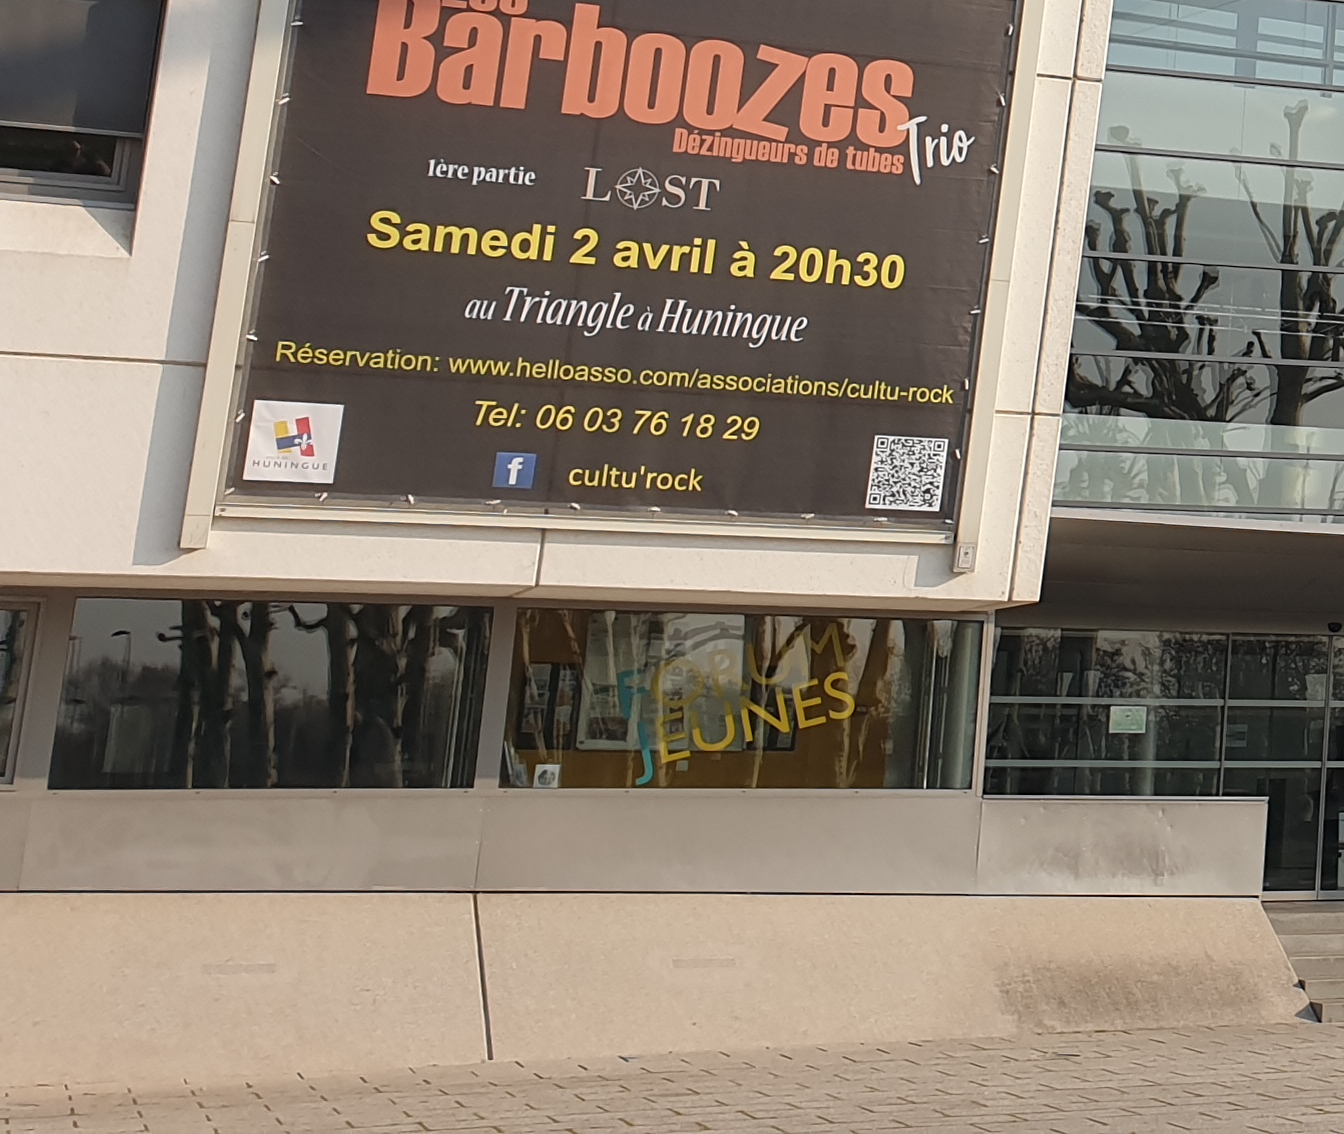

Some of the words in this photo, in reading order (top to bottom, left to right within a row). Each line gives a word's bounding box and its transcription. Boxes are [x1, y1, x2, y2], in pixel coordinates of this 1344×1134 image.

[471, 166, 537, 186] partie
[672, 127, 808, 166] Dézingueurs
[812, 142, 840, 169] de
[845, 146, 905, 175] tubes
[896, 115, 976, 186] Trio
[366, 210, 556, 262] Samedi
[568, 228, 599, 265] 2
[612, 237, 717, 275] avril
[729, 241, 756, 278] à
[769, 244, 906, 290] 20h30
[464, 298, 497, 321] au
[502, 286, 635, 337] Triangle
[636, 306, 654, 332] à
[655, 298, 809, 349] Huningue
[275, 341, 440, 373] Réservation:
[448, 356, 955, 405] www.helloasso.com/associations/cultu-rock
[474, 400, 527, 428] Tel:
[535, 404, 576, 432] 06
[582, 406, 623, 434] 03
[631, 409, 670, 437] 76
[679, 413, 716, 440] 18
[721, 415, 761, 442] 29
[252, 459, 328, 471] HUNINGUE
[568, 463, 704, 493] cultu'rock
[634, 670, 857, 786] JEUNES
